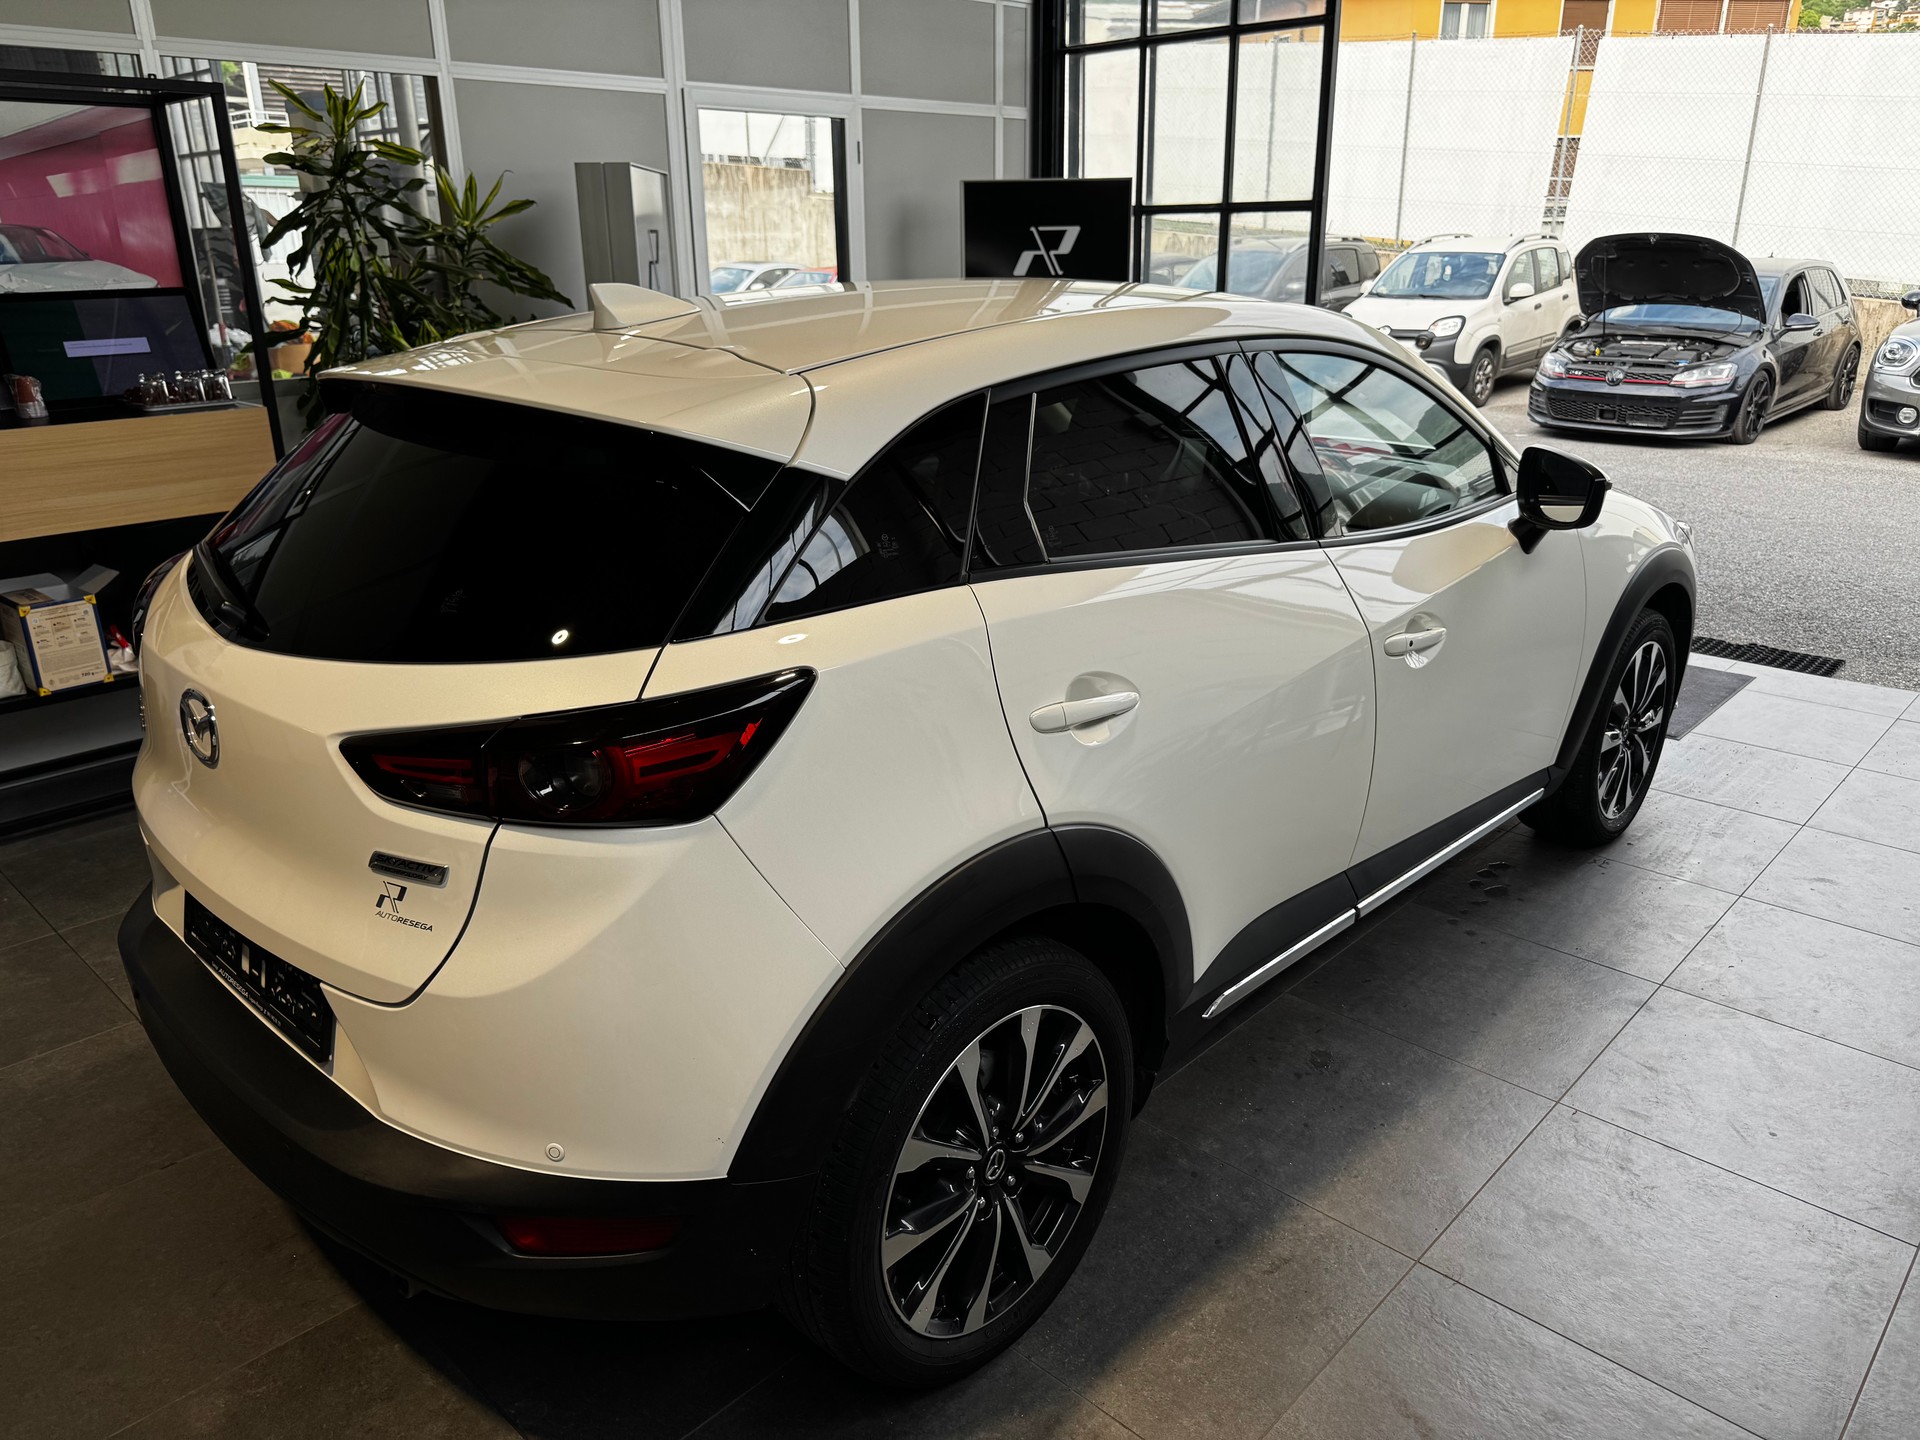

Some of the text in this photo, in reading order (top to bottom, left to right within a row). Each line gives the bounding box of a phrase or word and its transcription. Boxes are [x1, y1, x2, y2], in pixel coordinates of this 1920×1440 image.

[376, 854, 437, 873] SKYACTIV
[380, 866, 429, 880] TECHNOLOGY
[375, 910, 433, 932] AUTORESEGA
